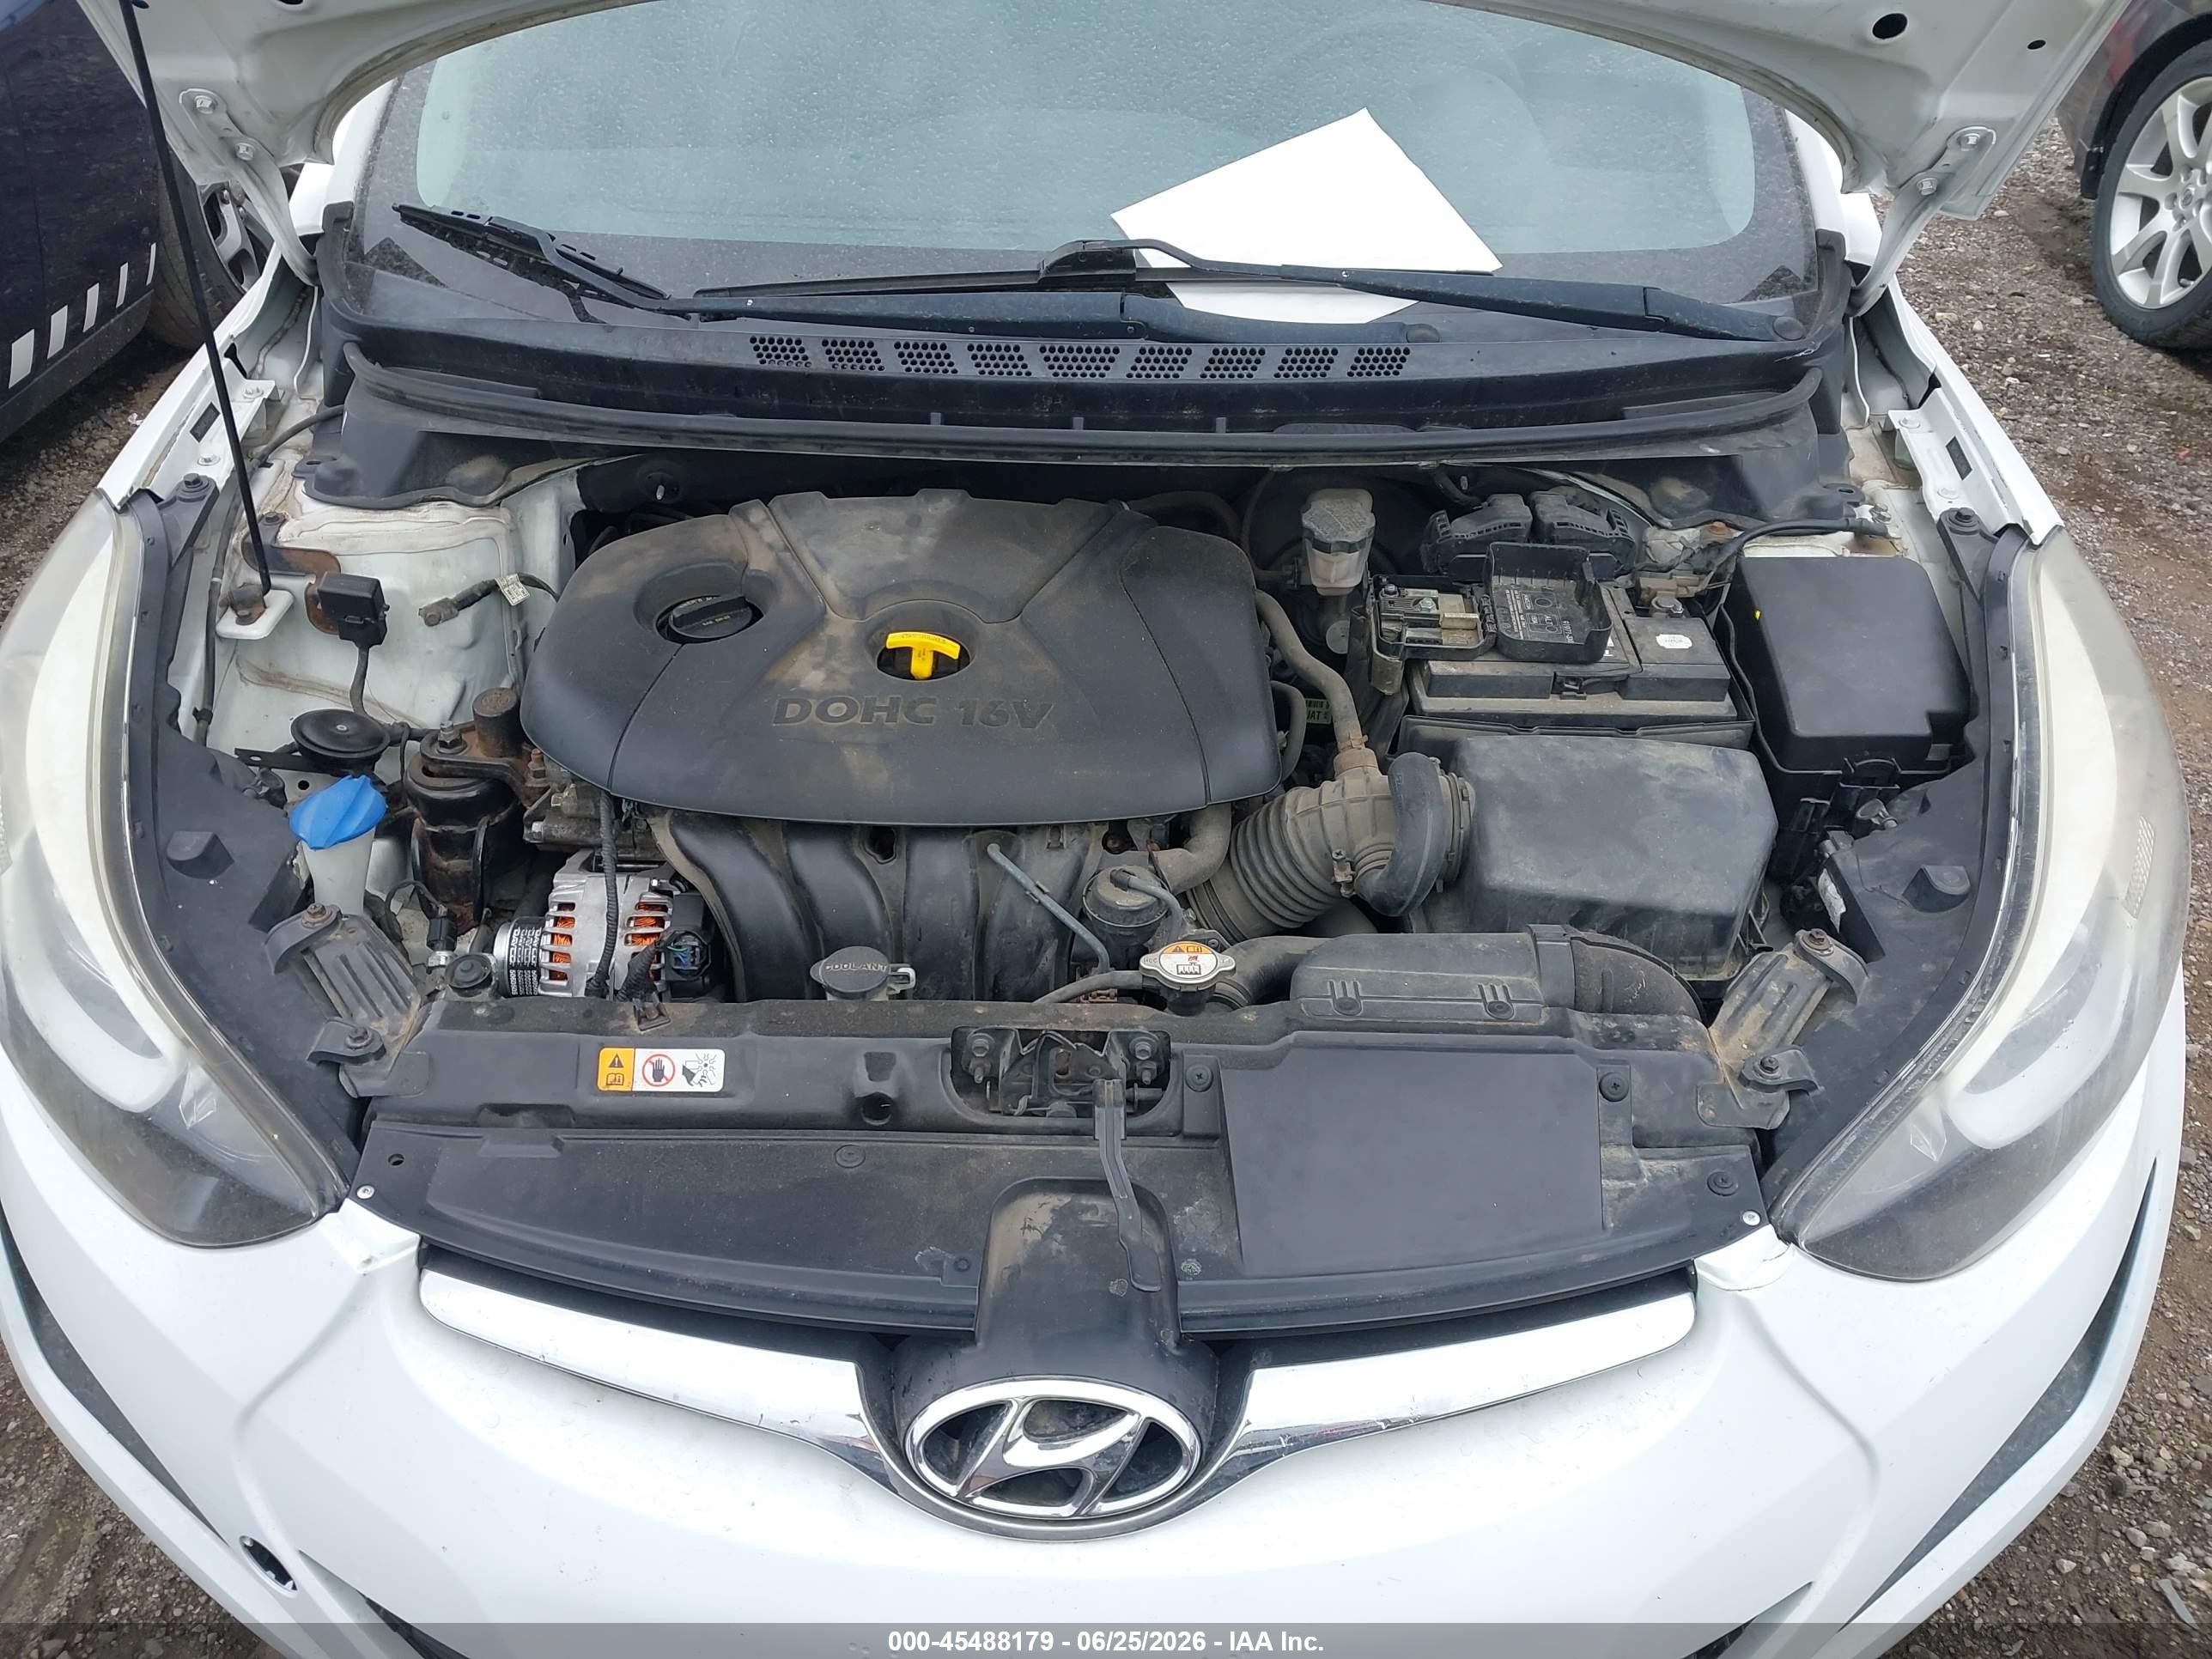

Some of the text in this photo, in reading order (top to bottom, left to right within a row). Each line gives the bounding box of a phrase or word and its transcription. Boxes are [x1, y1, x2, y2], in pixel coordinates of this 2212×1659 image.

[773, 696, 1054, 728] DOHC 16V
[509, 927, 520, 963] DAYCO
[825, 962, 888, 973] COOLANT
